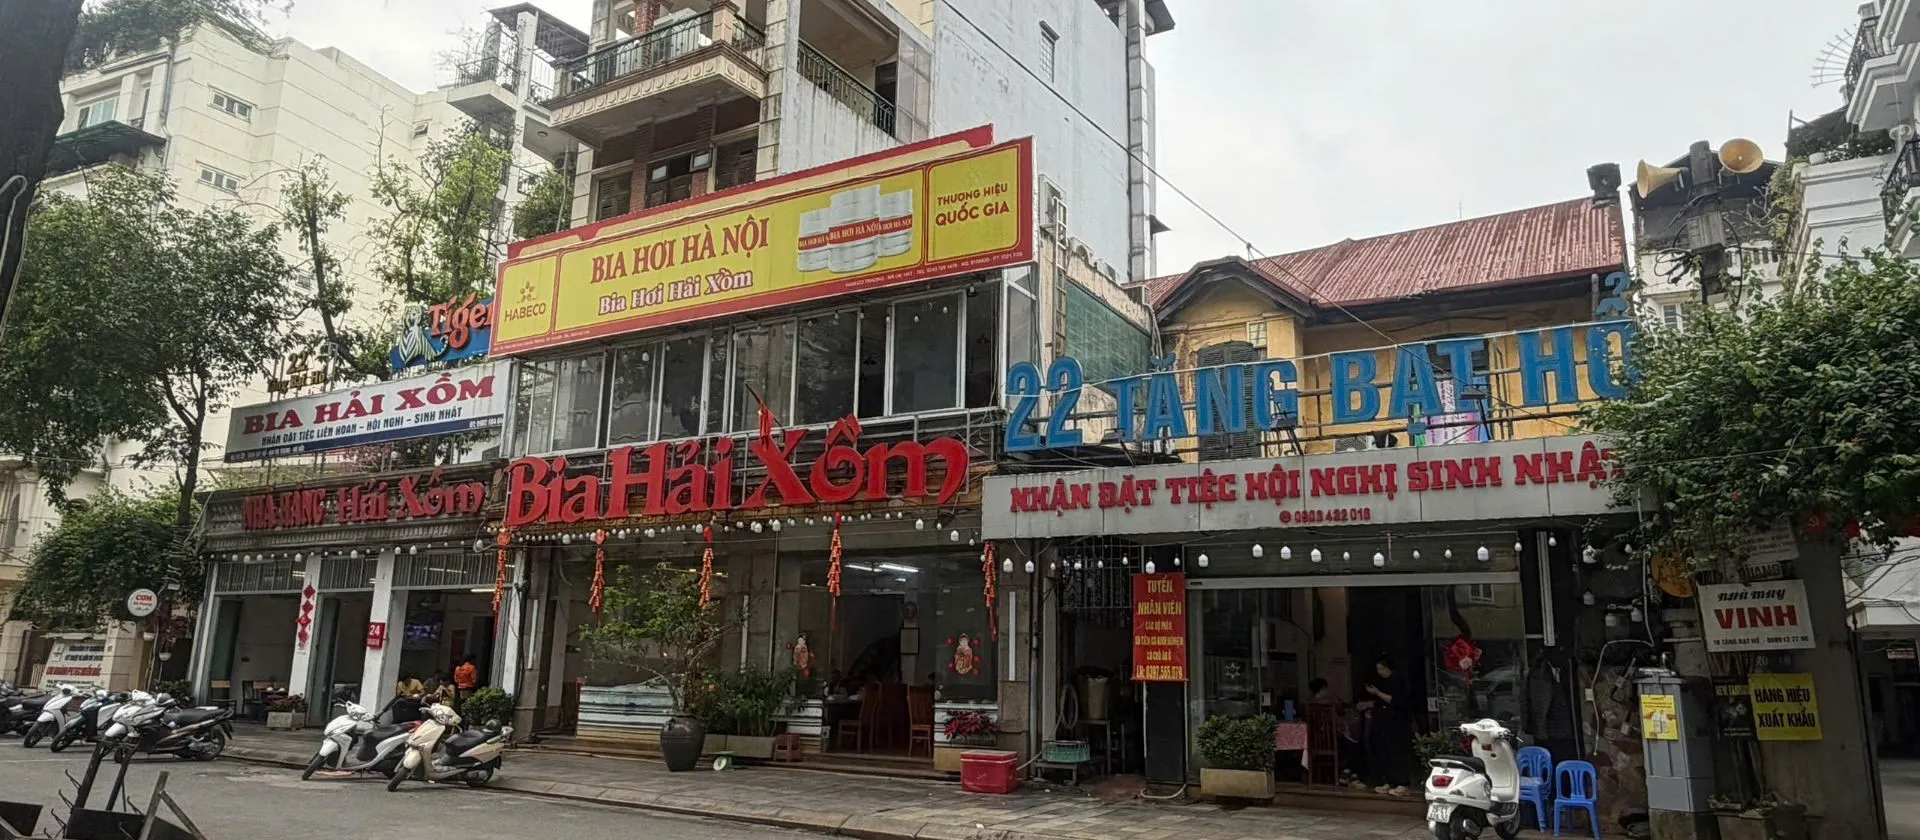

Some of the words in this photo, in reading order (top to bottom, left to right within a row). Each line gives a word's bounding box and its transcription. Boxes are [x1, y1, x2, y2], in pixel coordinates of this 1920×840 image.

[937, 189, 981, 206] THƯƠNG
[983, 182, 1008, 201] HIỆU
[935, 203, 979, 226] QUỐC
[983, 200, 1010, 217] GIA
[590, 250, 627, 284] BIA
[632, 238, 675, 275] HƠI
[681, 224, 716, 265] HÀ
[721, 214, 770, 259] NỘI
[598, 291, 627, 316] Bia
[630, 281, 664, 309] Hơi
[703, 267, 753, 295] Xồm
[504, 302, 546, 322] HABECO
[243, 409, 303, 435] BIA
[313, 390, 386, 425] HẢI
[395, 372, 495, 411] XỒM
[1005, 356, 1083, 454] 22
[1108, 352, 1299, 443] TĂNG
[1331, 337, 1486, 434] BẠT
[335, 423, 357, 436] HOAN
[414, 410, 436, 424] SINH
[505, 454, 600, 526] Bia
[605, 435, 735, 518] Hải
[740, 413, 969, 510] Xồm
[1010, 477, 1092, 517] NHẬN
[1098, 474, 1157, 514] ĐẶT
[1165, 467, 1237, 509] TIỆC
[1245, 463, 1301, 506] HỘI
[1310, 463, 1398, 501] NGHỊ
[1407, 456, 1503, 492] SINH
[336, 478, 389, 523] Hải
[1138, 599, 1161, 615] NHÂN
[1163, 599, 1182, 615] VIÊN
[1714, 605, 1798, 629] VINH
[369, 624, 381, 636] 24
[1754, 685, 1785, 703] HÀNG
[1757, 708, 1785, 728] XUẤT
[1786, 706, 1816, 728] KHẨU
